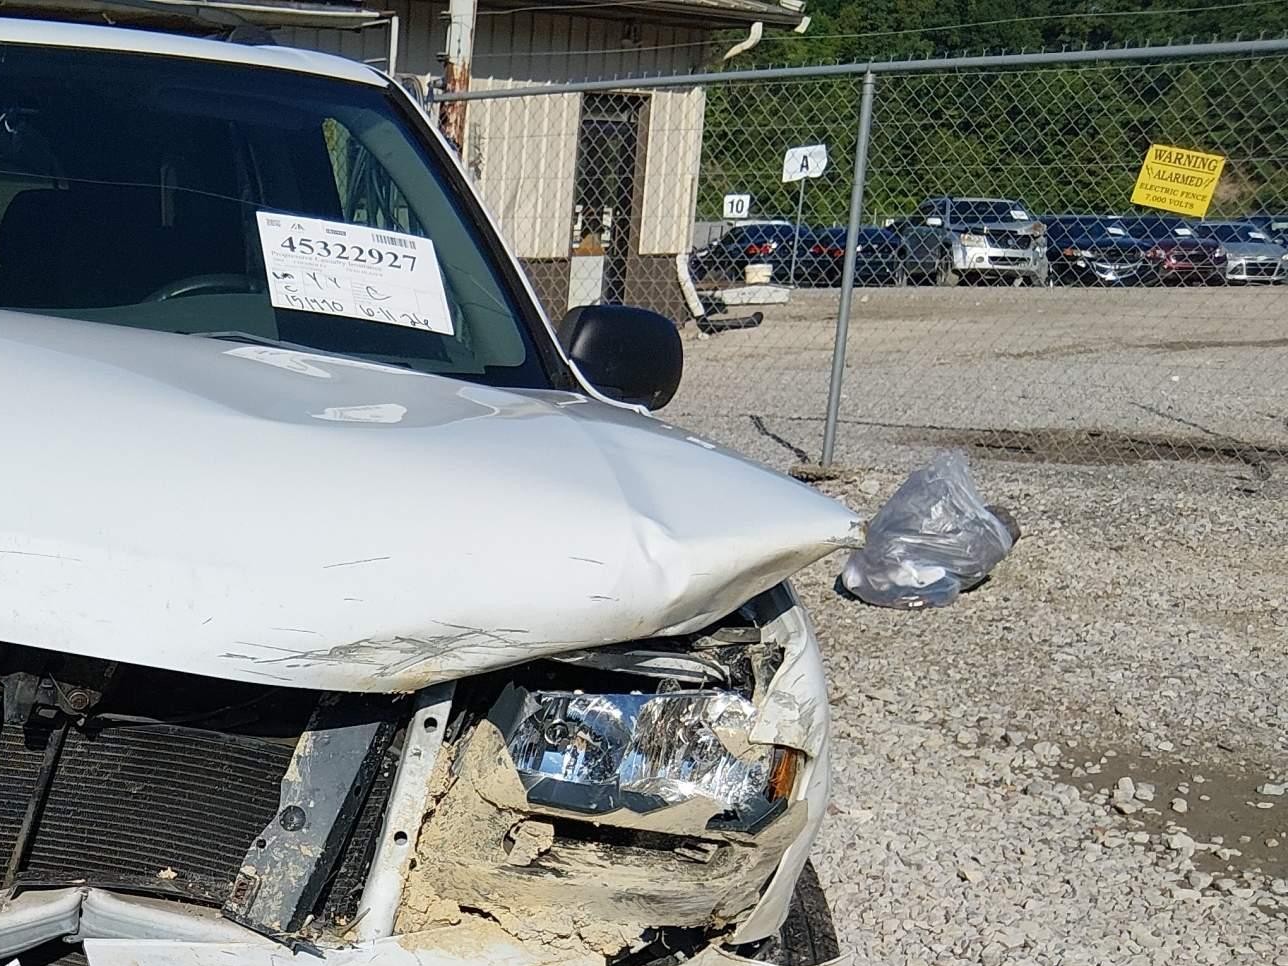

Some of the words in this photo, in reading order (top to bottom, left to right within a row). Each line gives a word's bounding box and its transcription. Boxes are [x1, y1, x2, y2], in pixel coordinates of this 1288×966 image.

[800, 155, 809, 172] A
[1154, 149, 1218, 172] WARNING
[1154, 169, 1203, 188] ALARMED
[1139, 182, 1179, 196] ELECTRIC
[1180, 190, 1208, 202] FENCE
[1145, 193, 1167, 204] 7,000
[1168, 198, 1194, 209] VOLTS
[728, 199, 744, 214] 10
[280, 236, 416, 271] 45322927
